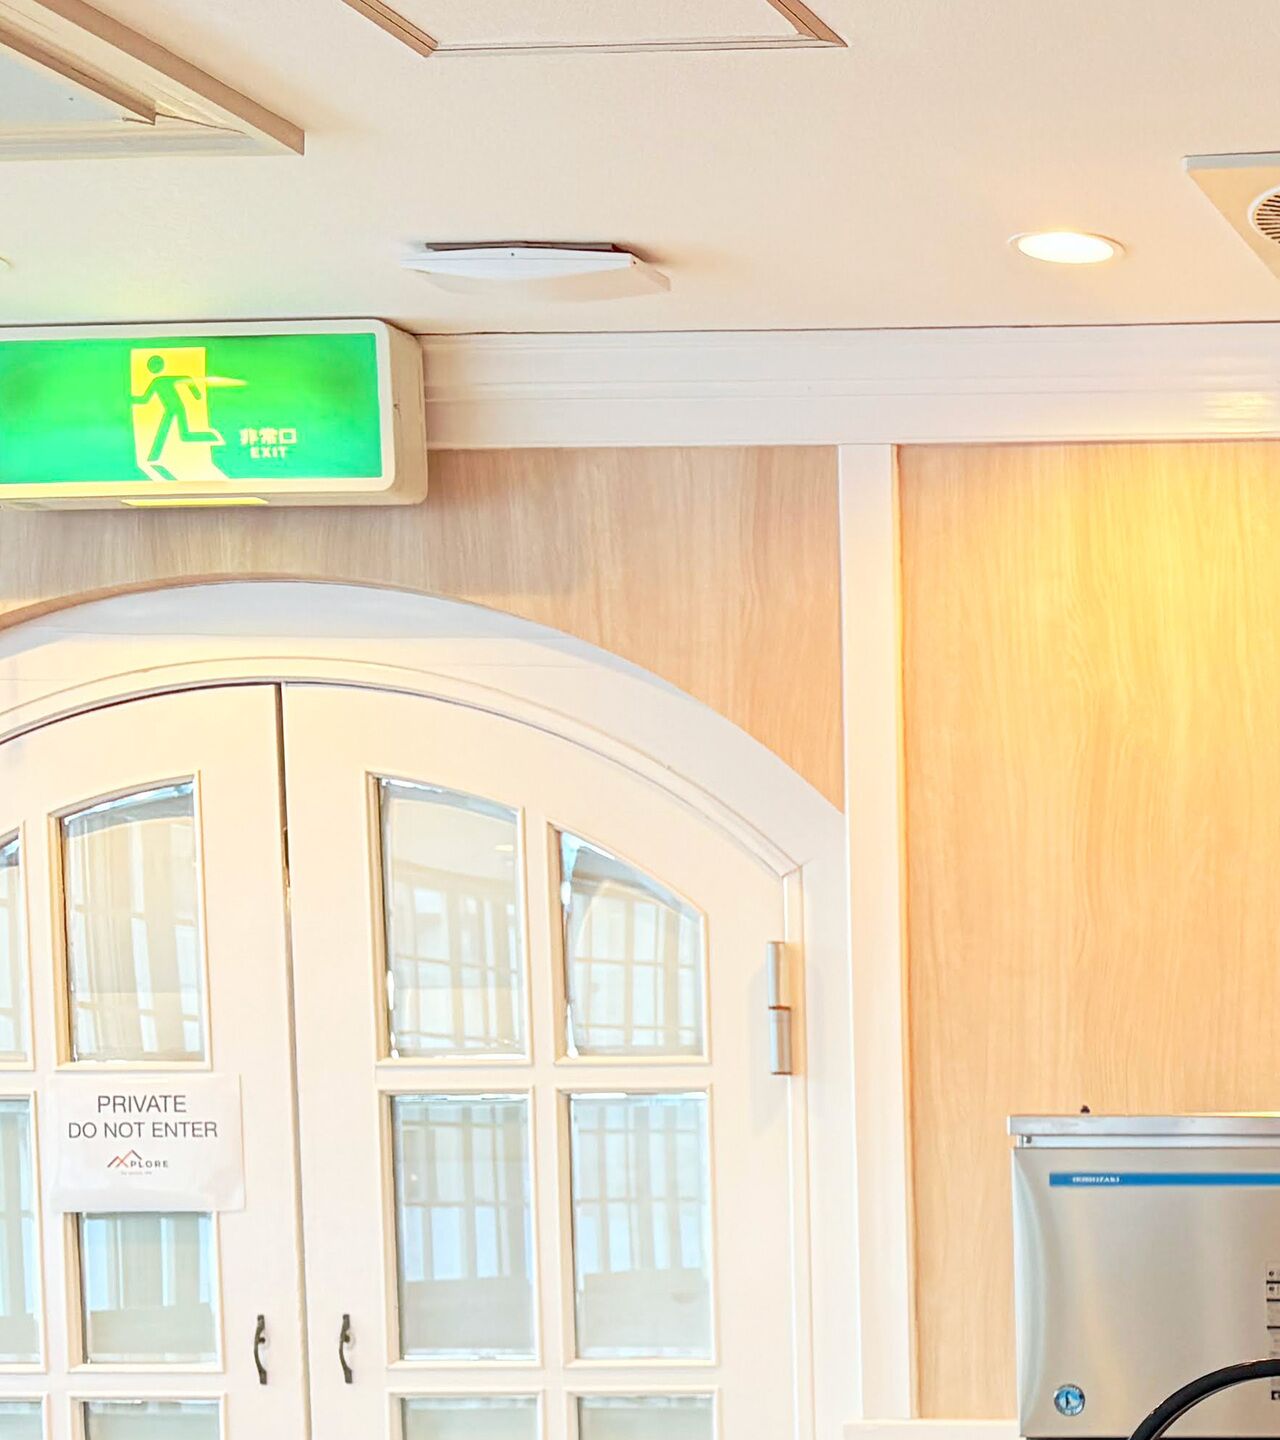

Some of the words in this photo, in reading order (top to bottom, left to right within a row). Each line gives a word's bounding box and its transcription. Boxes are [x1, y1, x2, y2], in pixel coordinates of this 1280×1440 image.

[240, 428, 297, 445] 非常口
[250, 447, 287, 459] EXIT
[97, 1095, 187, 1113] PRIVATE
[68, 1122, 97, 1139] DO
[104, 1122, 145, 1138] NOT
[152, 1121, 218, 1138] ENTER
